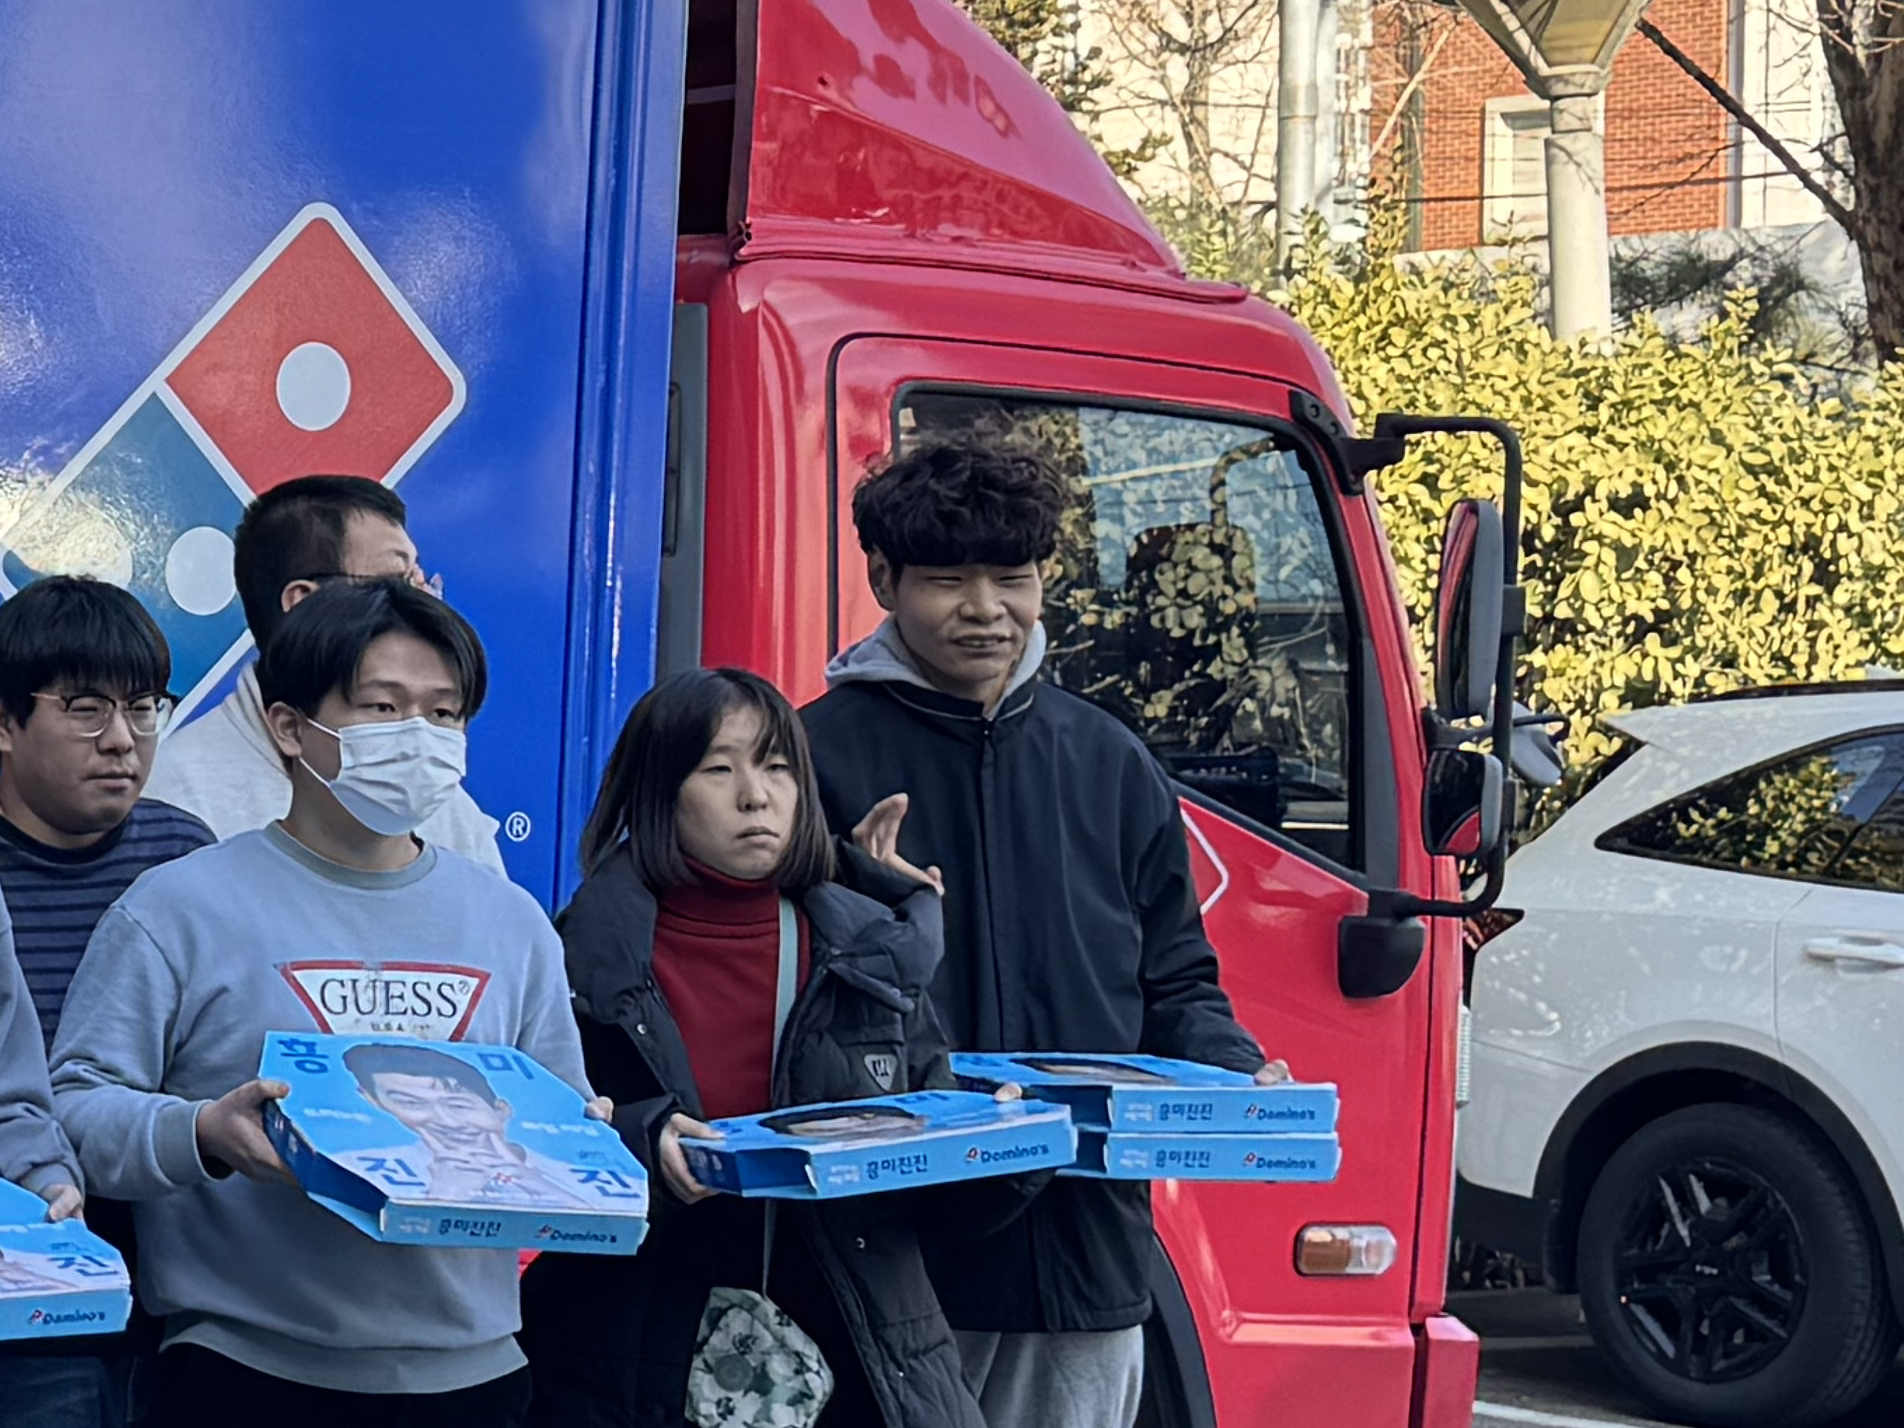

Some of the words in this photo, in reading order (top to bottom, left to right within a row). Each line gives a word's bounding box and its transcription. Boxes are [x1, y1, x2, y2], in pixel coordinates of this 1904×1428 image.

[477, 1052, 534, 1080] 미
[357, 1155, 426, 1188] 진
[568, 1167, 641, 1199] 진
[46, 1253, 120, 1278] 진
